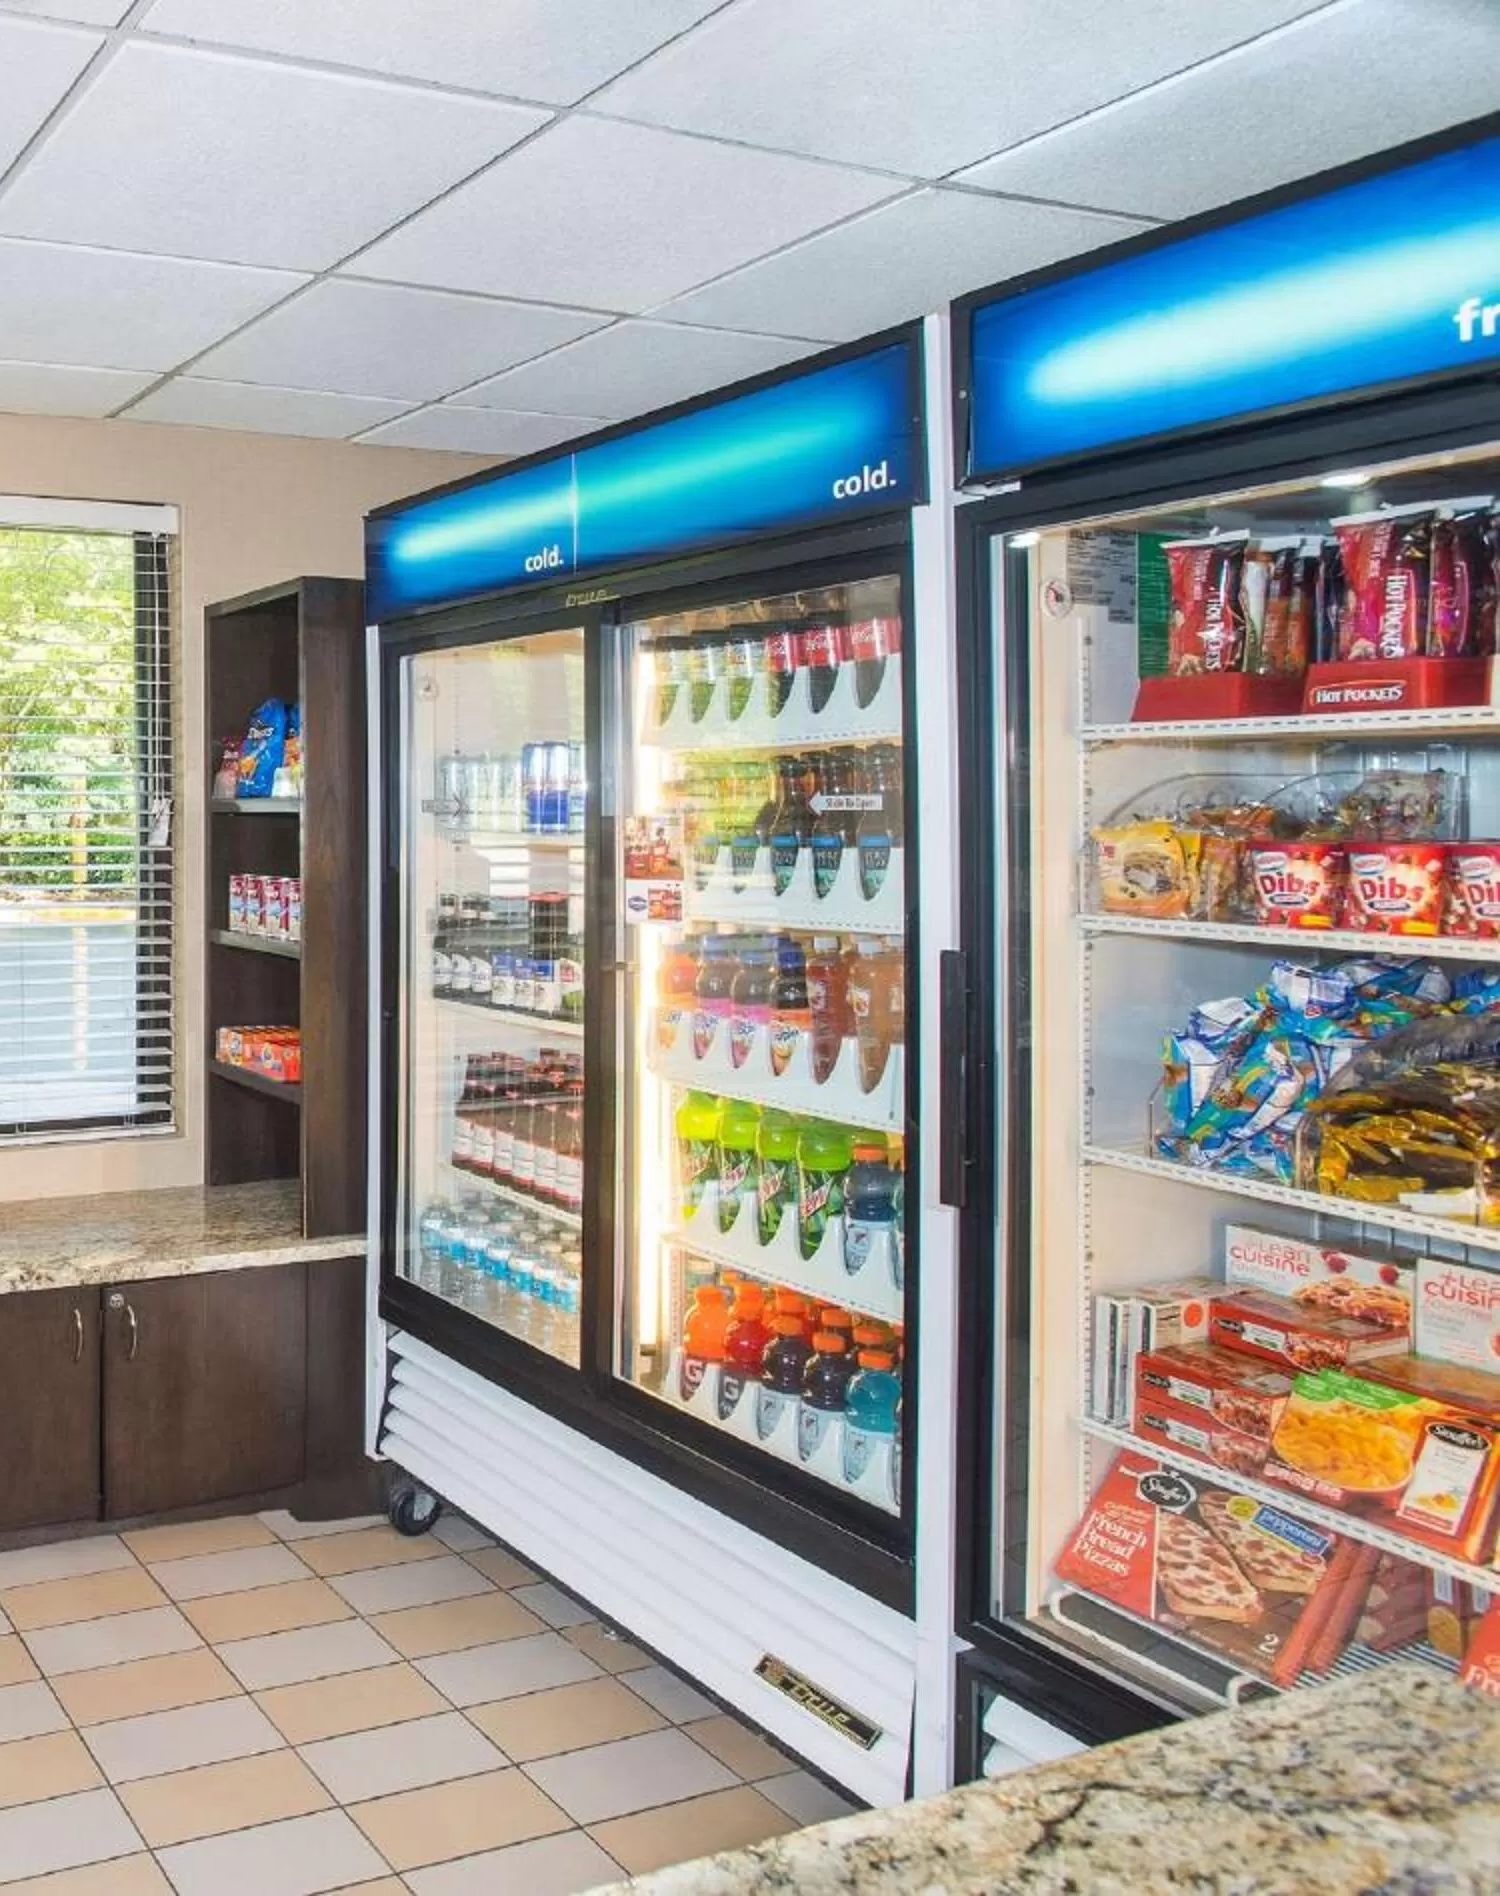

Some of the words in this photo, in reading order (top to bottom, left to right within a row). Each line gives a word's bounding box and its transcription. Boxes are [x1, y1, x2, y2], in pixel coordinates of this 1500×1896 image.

[832, 461, 898, 499] cold.
[524, 545, 564, 573] cold.
[1259, 871, 1321, 897] Dibs
[1359, 876, 1425, 900] Dibs
[1080, 1526, 1137, 1560] Bread
[1088, 1510, 1147, 1548] French
[1071, 1539, 1131, 1577] Pizzas
[1258, 1633, 1280, 1654] 2
